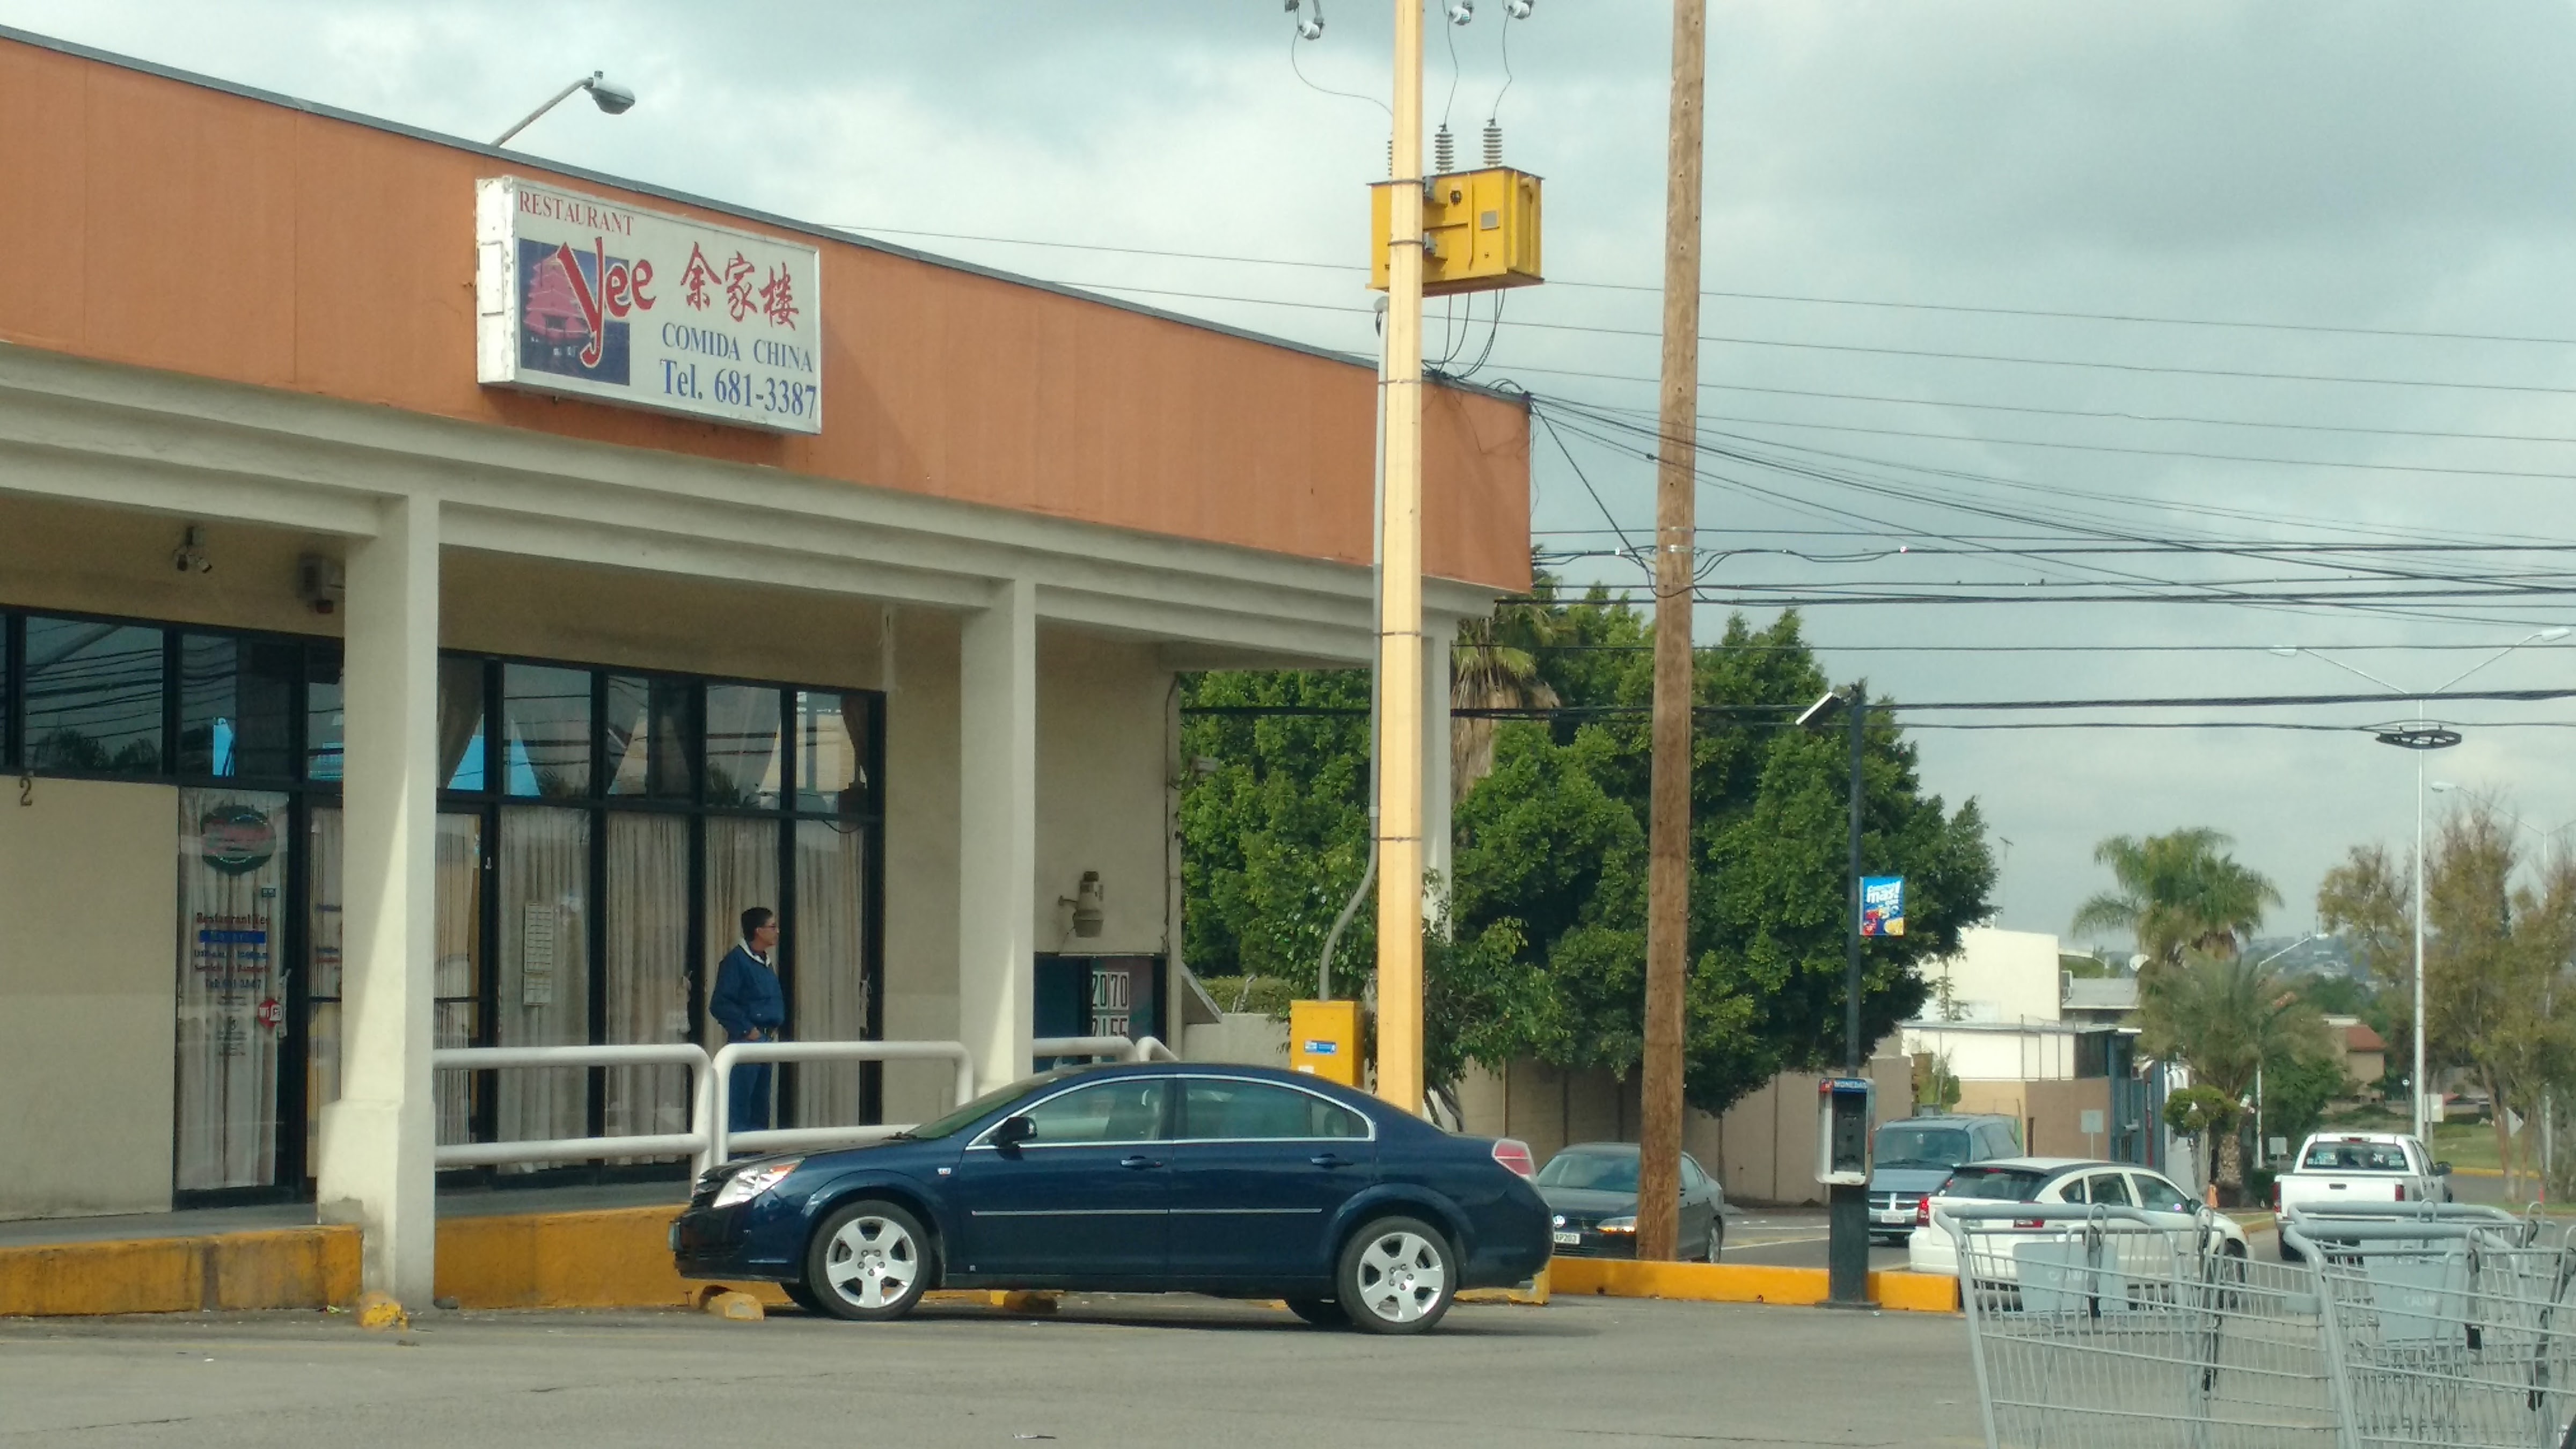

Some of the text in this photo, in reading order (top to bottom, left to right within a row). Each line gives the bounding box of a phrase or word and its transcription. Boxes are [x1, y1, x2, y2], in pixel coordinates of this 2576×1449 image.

[519, 190, 634, 236] RESTAURANT
[557, 236, 656, 366] Yee
[662, 322, 813, 373] COMIDA CHINA
[660, 358, 817, 420] Tel. 681-3387
[19, 777, 33, 806] 2
